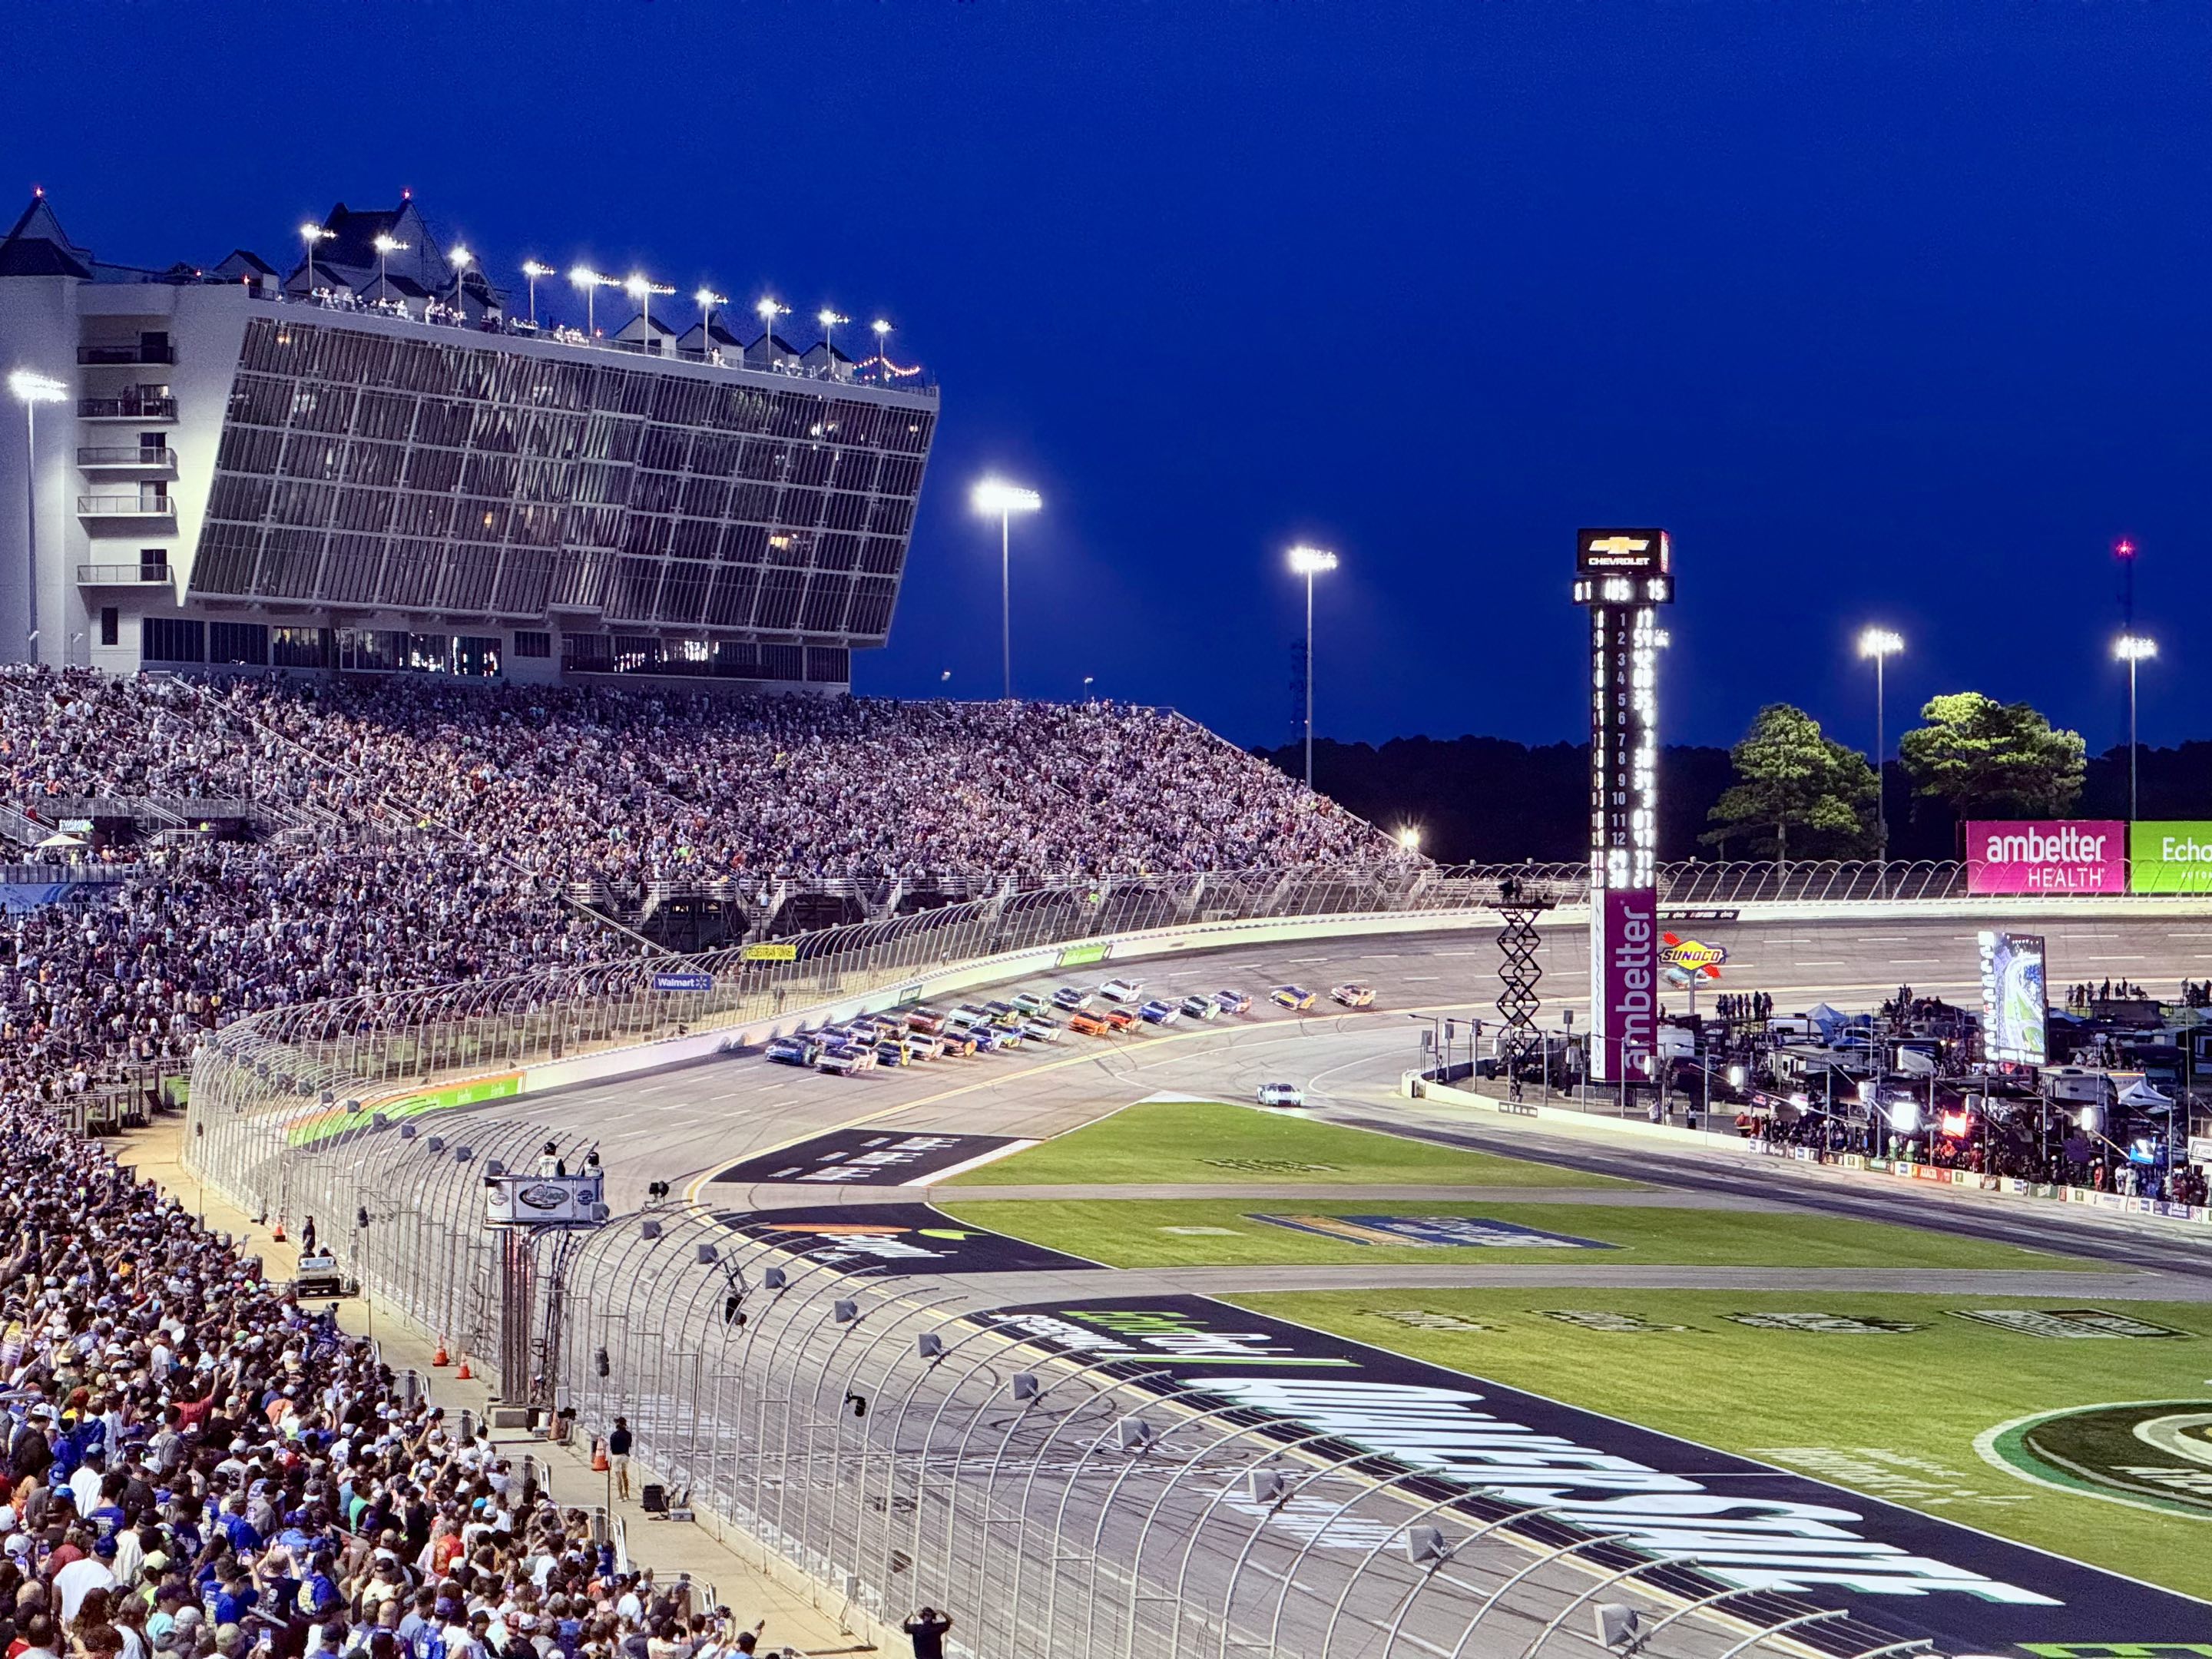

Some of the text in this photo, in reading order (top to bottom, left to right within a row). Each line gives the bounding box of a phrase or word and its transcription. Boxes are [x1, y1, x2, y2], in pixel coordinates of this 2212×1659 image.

[1588, 558, 1650, 566] CHEVROLET
[1620, 613, 1626, 626] 1
[1618, 631, 1625, 645] 2
[1618, 653, 1626, 667] 3
[1617, 671, 1626, 684] 4
[1618, 693, 1626, 707] 5
[1618, 712, 1626, 725] 6
[1618, 733, 1626, 746] 7
[1618, 751, 1626, 765] 8
[1618, 773, 1626, 786] 9
[1611, 792, 1626, 805] 10
[1611, 813, 1626, 826] 11
[1611, 833, 1626, 846] 12
[1986, 826, 2106, 863] ambetter
[2028, 868, 2101, 887] HEALTH
[1661, 949, 1721, 962] SUNOCO
[657, 978, 695, 988] Walmart
[1615, 906, 1651, 1070] ambetter
[1920, 1167, 1938, 1180] AXALTA
[988, 1314, 1137, 1350] SPEEDWAY
[1060, 1310, 1294, 1355] EchoPark
[1744, 1447, 1959, 1488] Walmart
[1180, 1377, 2066, 1605] QUAKER STATE
